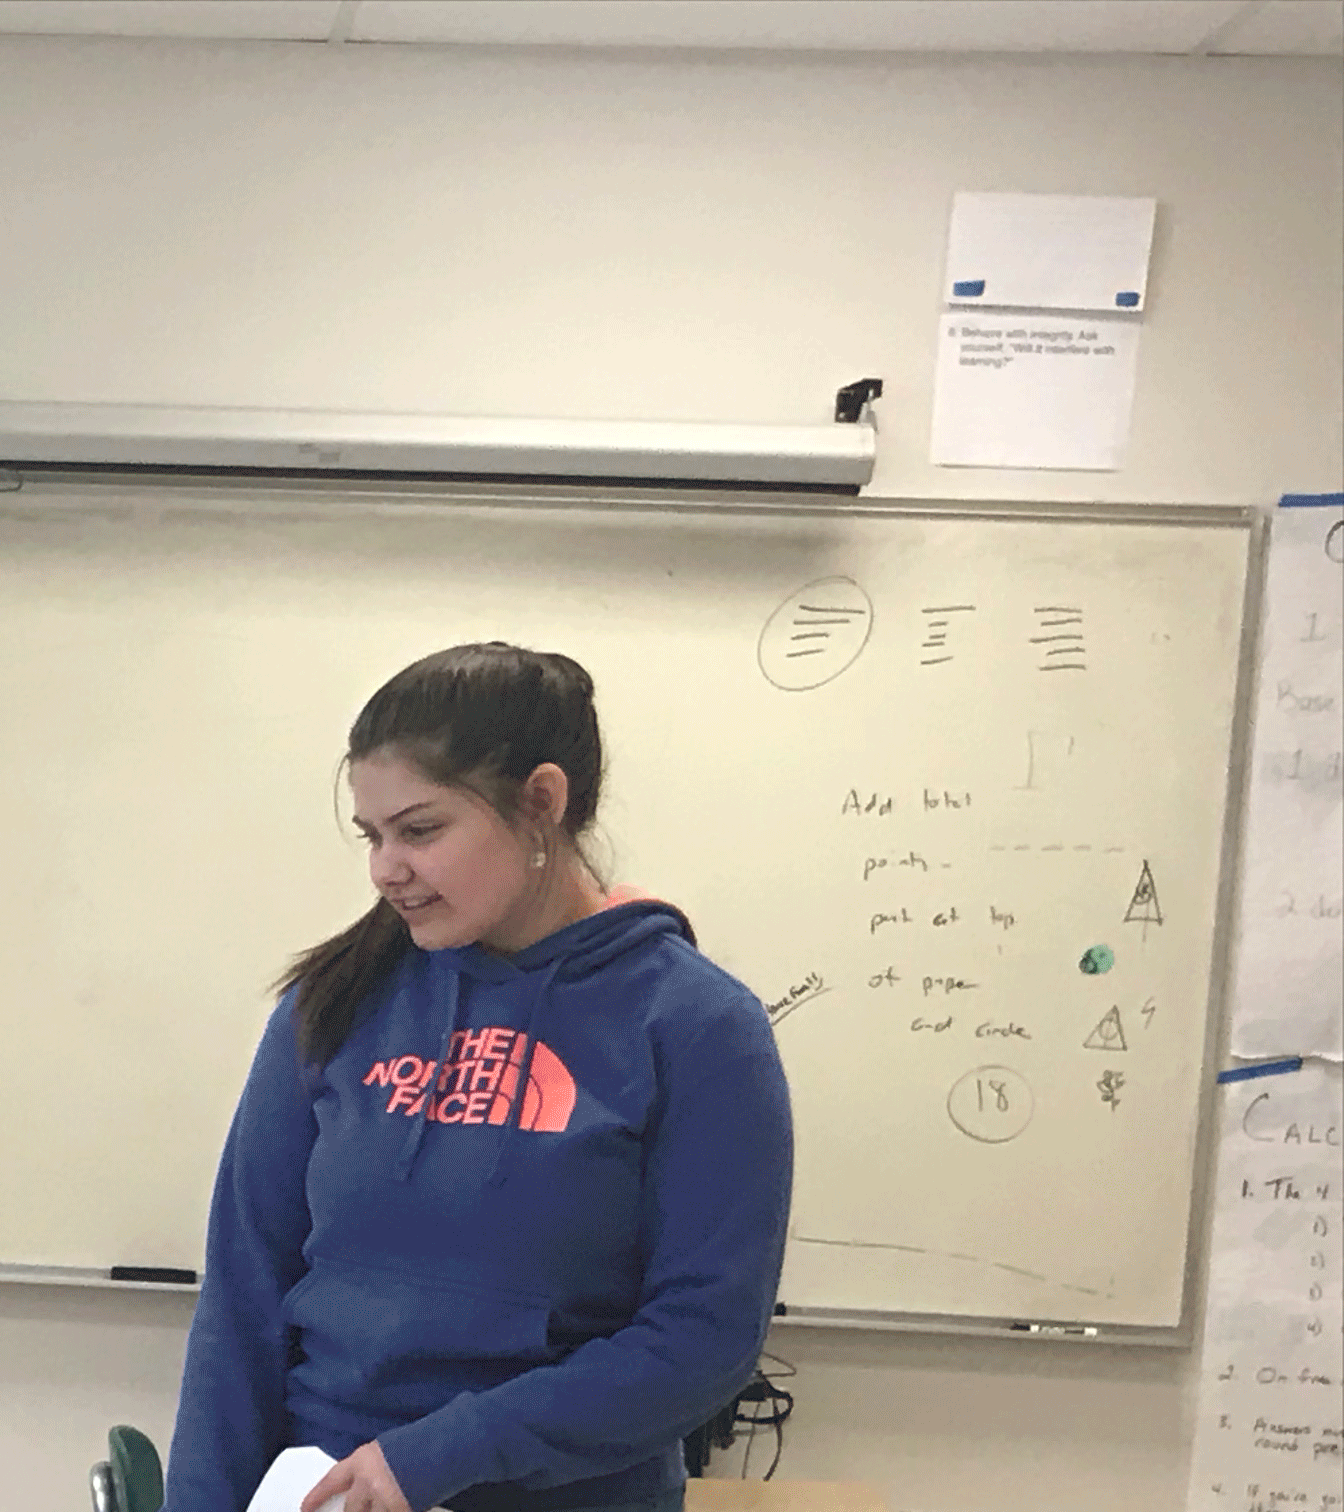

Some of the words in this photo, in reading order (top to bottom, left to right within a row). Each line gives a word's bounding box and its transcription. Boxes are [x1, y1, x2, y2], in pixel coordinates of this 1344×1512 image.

[1006, 329, 1027, 339] with
[1078, 330, 1098, 340] Ask
[1093, 345, 1115, 355] with
[842, 788, 893, 817] Add
[448, 1027, 516, 1062] THE
[363, 1054, 505, 1092] NORTH
[385, 1085, 494, 1125] FACE
[976, 1078, 1010, 1113] 18
[1264, 1176, 1301, 1200] The
